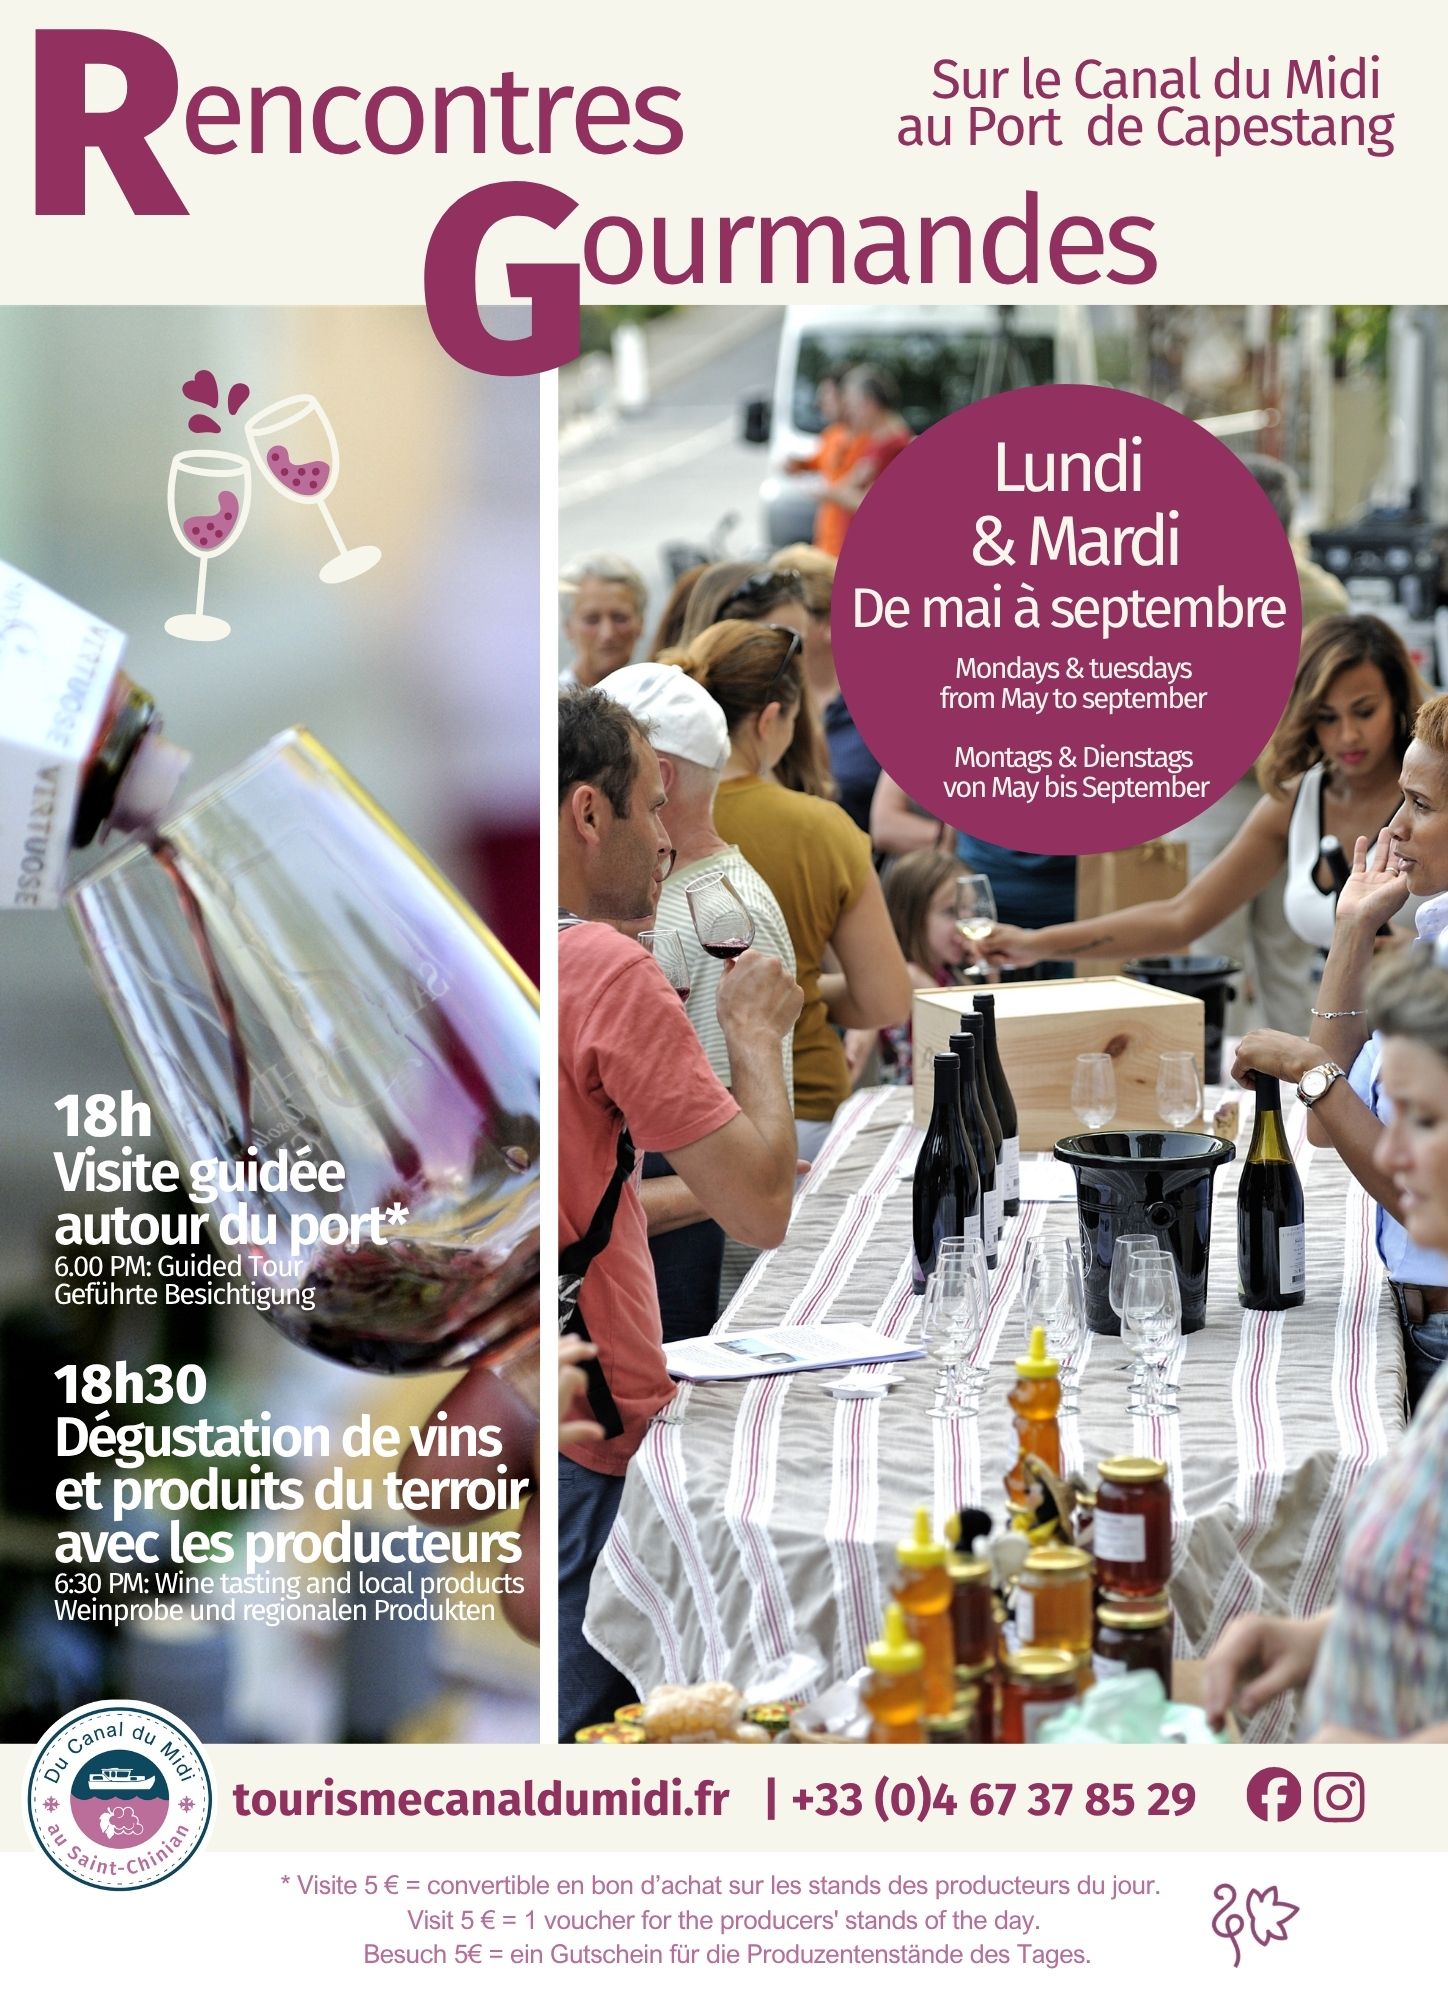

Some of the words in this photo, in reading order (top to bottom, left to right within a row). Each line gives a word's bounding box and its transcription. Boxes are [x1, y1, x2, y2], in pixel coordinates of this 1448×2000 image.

[932, 59, 1009, 99] Sur
[1023, 56, 1060, 99] le
[1075, 56, 1201, 99] Canal
[1214, 56, 1270, 99] du
[1287, 55, 1380, 99] Midi
[36, 29, 684, 215] Rencontres
[898, 114, 951, 146] au
[970, 107, 1063, 146] Port
[1088, 103, 1143, 146] de
[1158, 106, 1395, 157] Capestang
[424, 181, 1157, 376] Gourmandes
[998, 436, 1142, 492] Lundi
[973, 515, 1016, 566] &
[1030, 510, 1179, 566] Mardi
[855, 588, 910, 628] De
[924, 583, 1001, 628] mai
[1014, 582, 1040, 628] à
[1051, 585, 1286, 639] septembre
[956, 656, 1060, 684] Mondays
[1066, 657, 1084, 679] &
[1089, 656, 1192, 684] tuesdays
[940, 686, 994, 708] from
[1002, 688, 1047, 714] May
[1053, 690, 1076, 709] to
[1082, 686, 1208, 715] september
[955, 747, 1052, 774] Montags
[1059, 747, 1077, 768] &
[1084, 744, 1193, 774] Dienstags
[943, 781, 985, 798] von
[992, 776, 1039, 803] May
[1046, 774, 1077, 798] bis
[1082, 775, 1210, 804] September
[54, 1089, 151, 1137] 18h
[53, 1145, 179, 1192] Visite
[189, 1145, 346, 1203] guidée
[55, 1206, 209, 1245] autour
[219, 1202, 276, 1245] du
[54, 1255, 103, 1277] 6.00
[111, 1255, 151, 1277] PM:
[158, 1253, 241, 1277] Guided
[248, 1255, 304, 1277] Tour
[55, 1281, 157, 1305] Geführte
[166, 1281, 316, 1310] Besichtigung
[54, 1360, 206, 1404] 18h30
[57, 1410, 329, 1468] Dégustation
[342, 1414, 400, 1457] de
[409, 1411, 503, 1457] vins
[56, 1472, 103, 1510] et
[114, 1464, 304, 1521] produits
[315, 1467, 372, 1510] du
[383, 1464, 529, 1510] terroir
[55, 1530, 160, 1563] avec
[170, 1520, 235, 1563] les
[247, 1520, 522, 1574] producteurs
[54, 1572, 101, 1594] 6:30
[110, 1572, 149, 1594] PM:
[155, 1570, 214, 1594] Wine
[220, 1570, 301, 1599] tasting
[306, 1571, 351, 1594] and
[359, 1571, 413, 1594] local
[421, 1571, 525, 1599] products
[54, 1597, 183, 1627] Weinprobe
[191, 1598, 235, 1621] und
[244, 1597, 366, 1627] regionalen
[375, 1598, 494, 1621] Produkten
[44, 1757, 68, 1783] Du
[67, 1721, 123, 1754] Canal
[132, 1726, 156, 1745] du
[160, 1741, 196, 1782] Midi
[232, 1777, 730, 1816] tourismecanaldumidi.fr
[792, 1783, 862, 1816] +33
[875, 1774, 957, 1822] (0)4
[970, 1783, 1016, 1816] 67
[1027, 1783, 1073, 1816] 37
[1085, 1783, 1135, 1816] 85
[1147, 1783, 1196, 1816] 29
[47, 1824, 67, 1847] au
[67, 1824, 189, 1875] Saint-Chinian
[297, 1875, 357, 1895] Visite
[365, 1875, 377, 1895] 5
[384, 1875, 399, 1895] €
[428, 1875, 549, 1895] convertible
[557, 1880, 583, 1895] en
[592, 1875, 633, 1895] bon
[729, 1880, 764, 1895] sur
[771, 1875, 801, 1895] les
[809, 1875, 881, 1895] stands
[888, 1875, 928, 1895] des
[936, 1875, 1070, 1900] producteurs
[1077, 1875, 1104, 1895] du
[1111, 1875, 1160, 1900] jour.
[407, 1910, 454, 1930] Visit
[461, 1910, 474, 1930] 5
[480, 1910, 495, 1930] €
[526, 1910, 533, 1929] 1
[544, 1910, 635, 1930] voucher
[641, 1910, 672, 1930] for
[678, 1910, 713, 1930] the
[846, 1910, 918, 1930] stands
[925, 1909, 947, 1930] of
[952, 1910, 987, 1930] the
[993, 1910, 1039, 1935] day.
[365, 1944, 446, 1964] Besuch
[455, 1944, 482, 1964] 5€
[511, 1944, 542, 1964] ein
[551, 1944, 662, 1964] Gutschein
[669, 1944, 700, 1964] für
[707, 1944, 740, 1964] die
[748, 1944, 963, 1965] Produzentenstände
[970, 1944, 1010, 1964] des
[1017, 1944, 1090, 1969] Tages.
